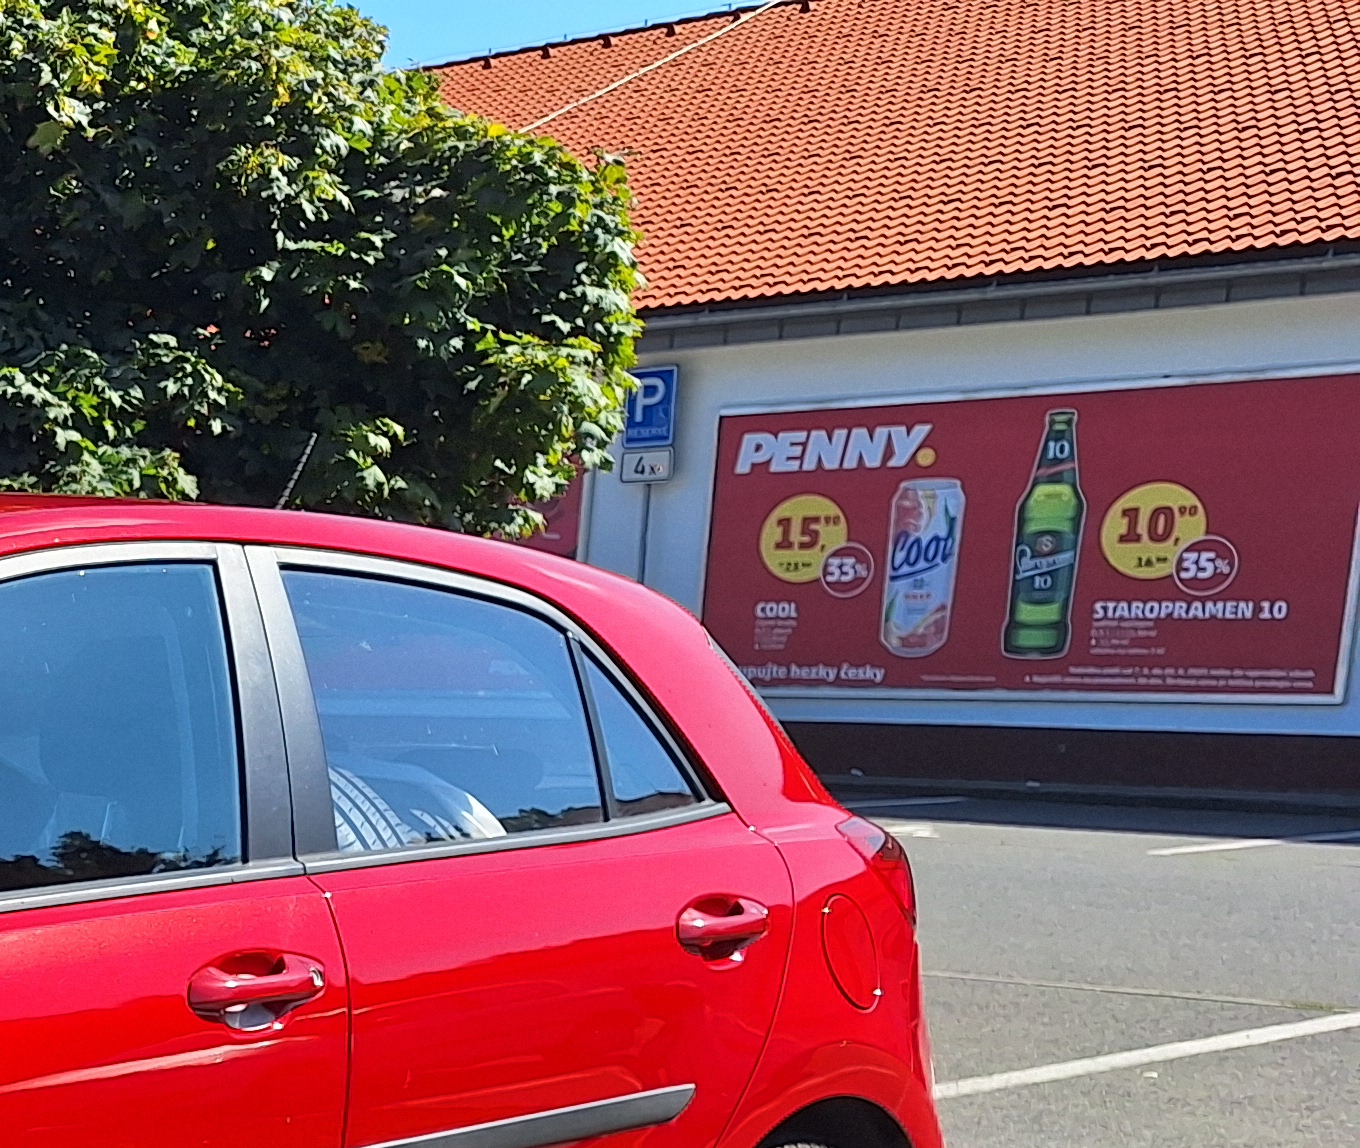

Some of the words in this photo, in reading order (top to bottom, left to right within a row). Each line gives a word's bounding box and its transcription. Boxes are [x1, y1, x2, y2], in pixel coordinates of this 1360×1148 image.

[634, 376, 666, 423] P
[1047, 439, 1071, 460] 10
[1181, 551, 1231, 580] 35%
[755, 600, 798, 618] COOL
[1092, 600, 1253, 619] STAROPRAMEN
[1258, 600, 1289, 619] 10
[739, 662, 788, 681] upujte
[790, 662, 838, 682] hezky
[839, 661, 886, 683] česky
